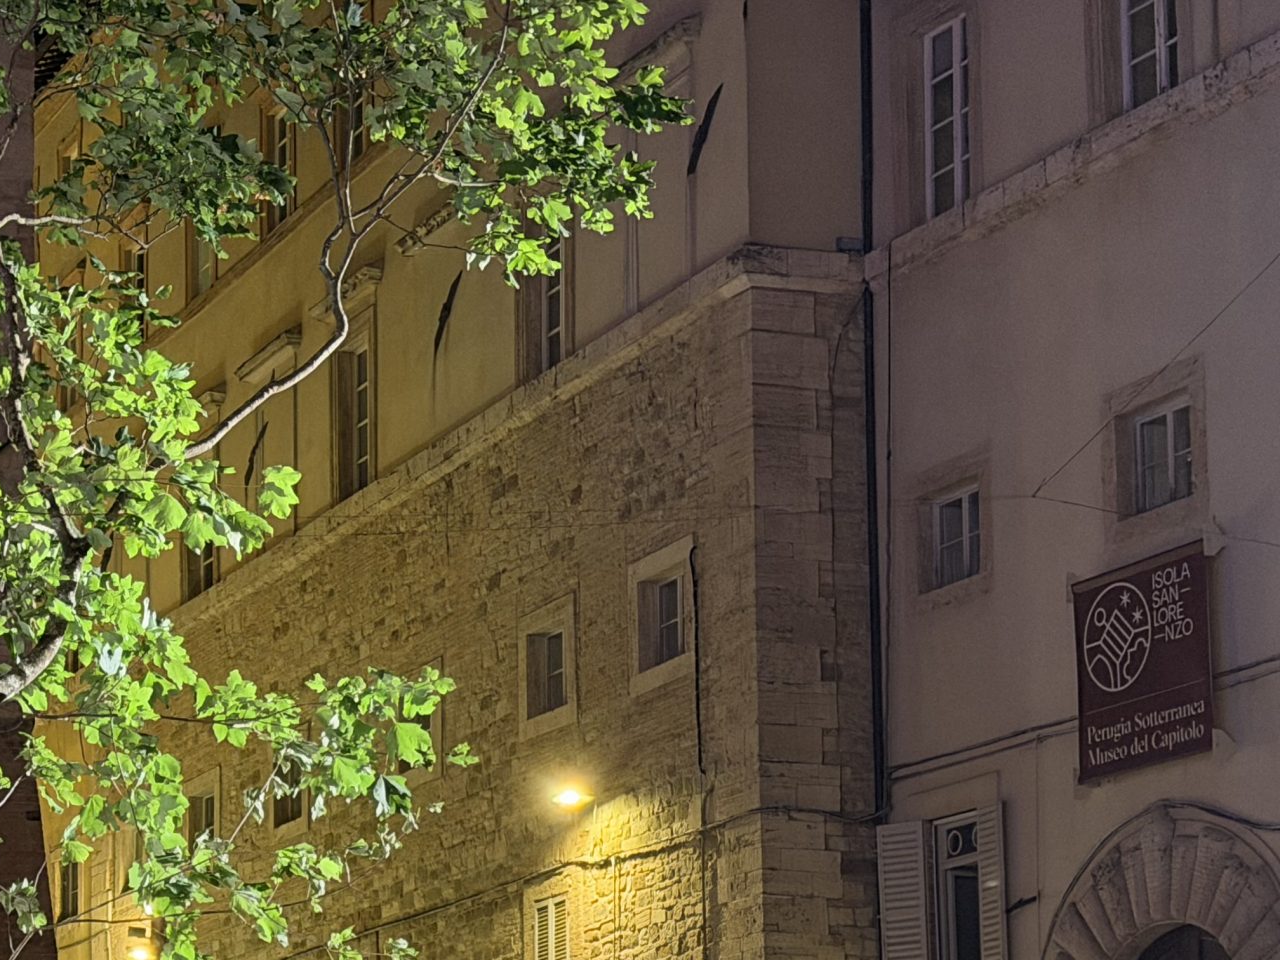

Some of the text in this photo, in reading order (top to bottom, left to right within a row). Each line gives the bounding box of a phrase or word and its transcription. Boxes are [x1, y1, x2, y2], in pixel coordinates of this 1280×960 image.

[1152, 562, 1190, 590] ISOLA
[1153, 601, 1185, 627] LORE
[1087, 700, 1205, 745] Perugia Sotterranea
[1088, 720, 1205, 767] Museo del Capitolo
